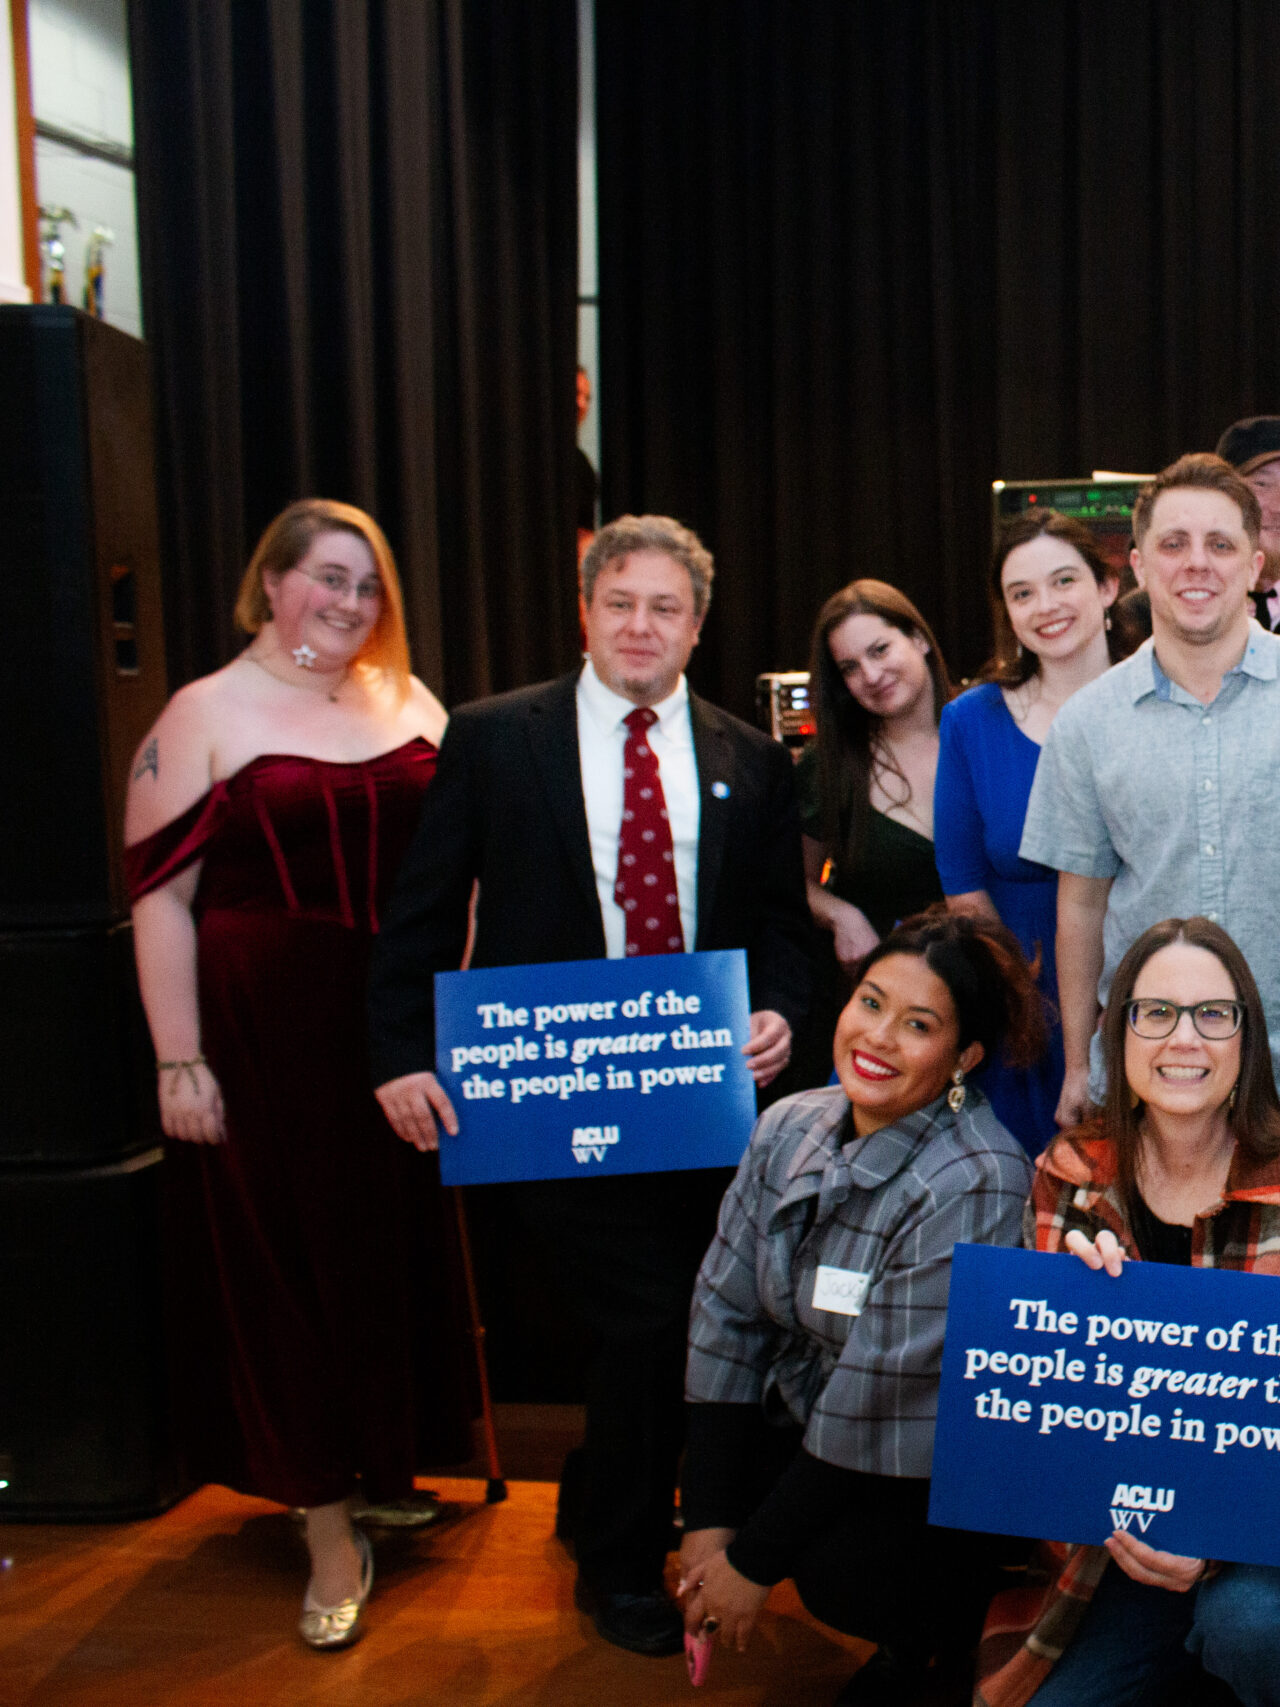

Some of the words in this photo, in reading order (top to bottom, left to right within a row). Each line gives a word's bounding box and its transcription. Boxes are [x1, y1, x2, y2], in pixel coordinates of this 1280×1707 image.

[476, 1002, 529, 1029] The
[533, 1001, 617, 1032] power
[621, 991, 653, 1019] of
[655, 989, 700, 1016] the
[450, 1036, 539, 1073] people
[543, 1034, 568, 1059] is
[570, 1032, 667, 1064] greater
[669, 1024, 734, 1051] than
[461, 1073, 505, 1100] the
[510, 1067, 601, 1104] people
[605, 1064, 634, 1090] in
[639, 1064, 726, 1095] power
[571, 1125, 620, 1147] ACLU
[571, 1146, 608, 1164] WV
[1009, 1298, 1079, 1335] The
[1085, 1315, 1199, 1348] power
[1205, 1320, 1249, 1353] of
[963, 1348, 1086, 1387] people
[1094, 1353, 1124, 1387] is
[1127, 1366, 1259, 1400] greater
[974, 1388, 1032, 1423] the
[1038, 1403, 1162, 1442] people
[1169, 1408, 1206, 1443] in
[1111, 1484, 1176, 1513] ACLU
[1109, 1509, 1156, 1534] WV
